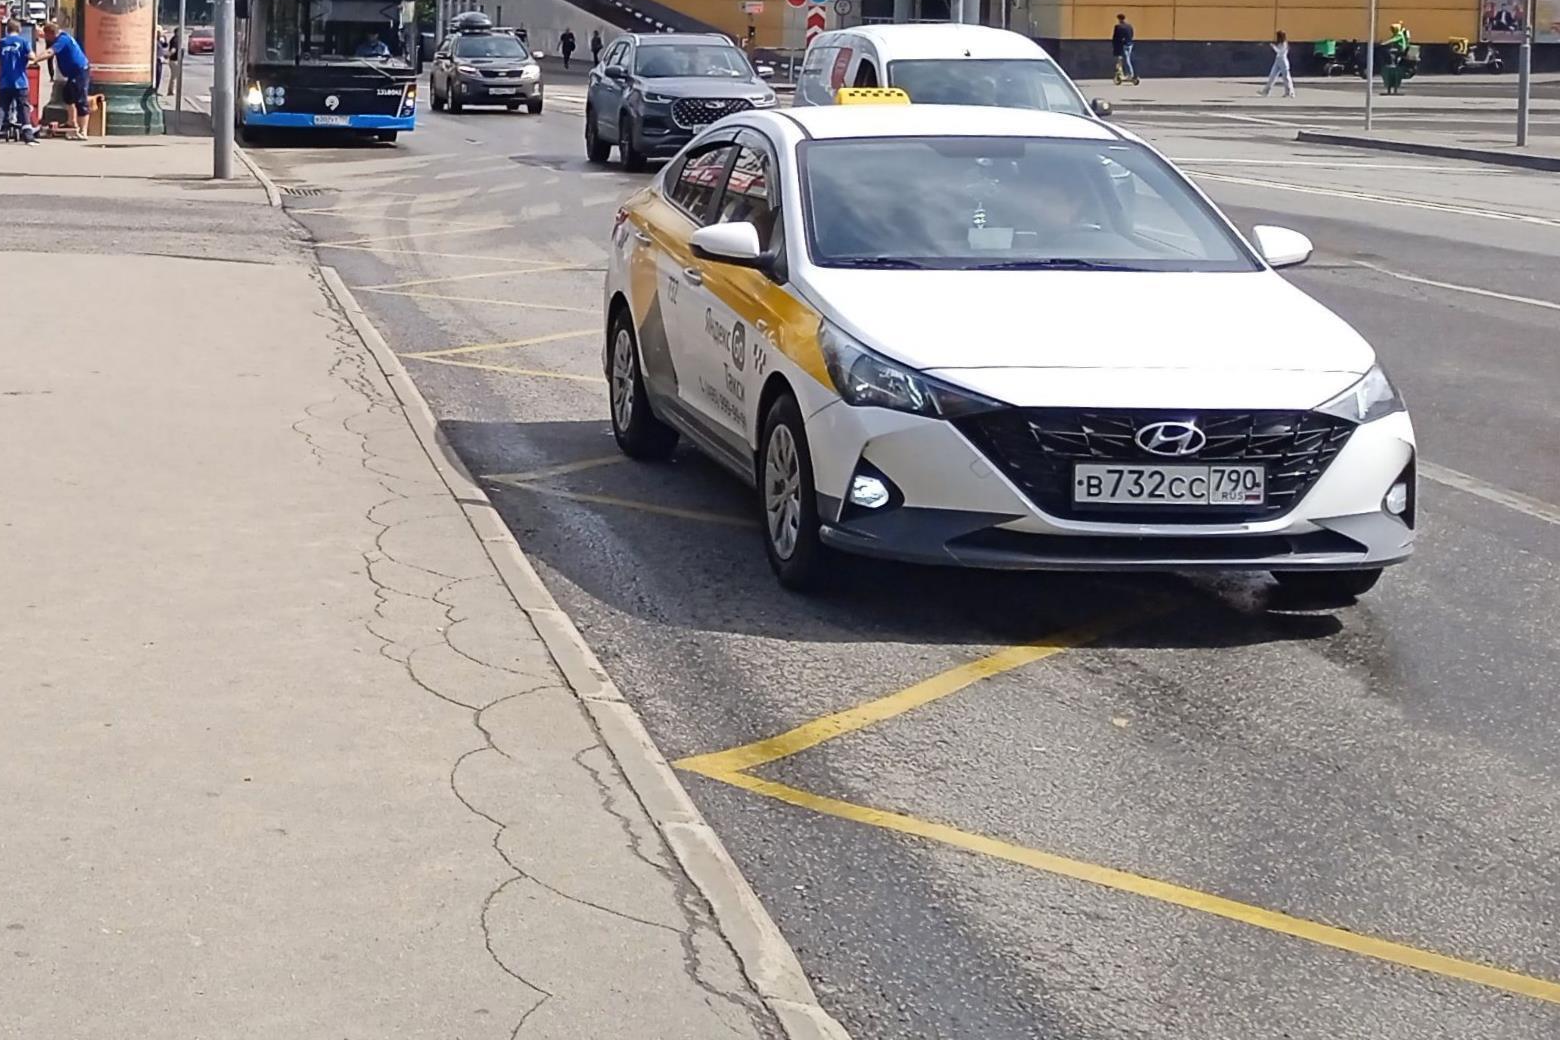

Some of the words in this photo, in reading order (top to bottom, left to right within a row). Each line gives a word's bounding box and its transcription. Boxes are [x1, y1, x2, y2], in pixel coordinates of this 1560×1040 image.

[1086, 469, 1206, 499] В732СС
[1212, 469, 1256, 492] 790
[1221, 491, 1244, 500] RUS
